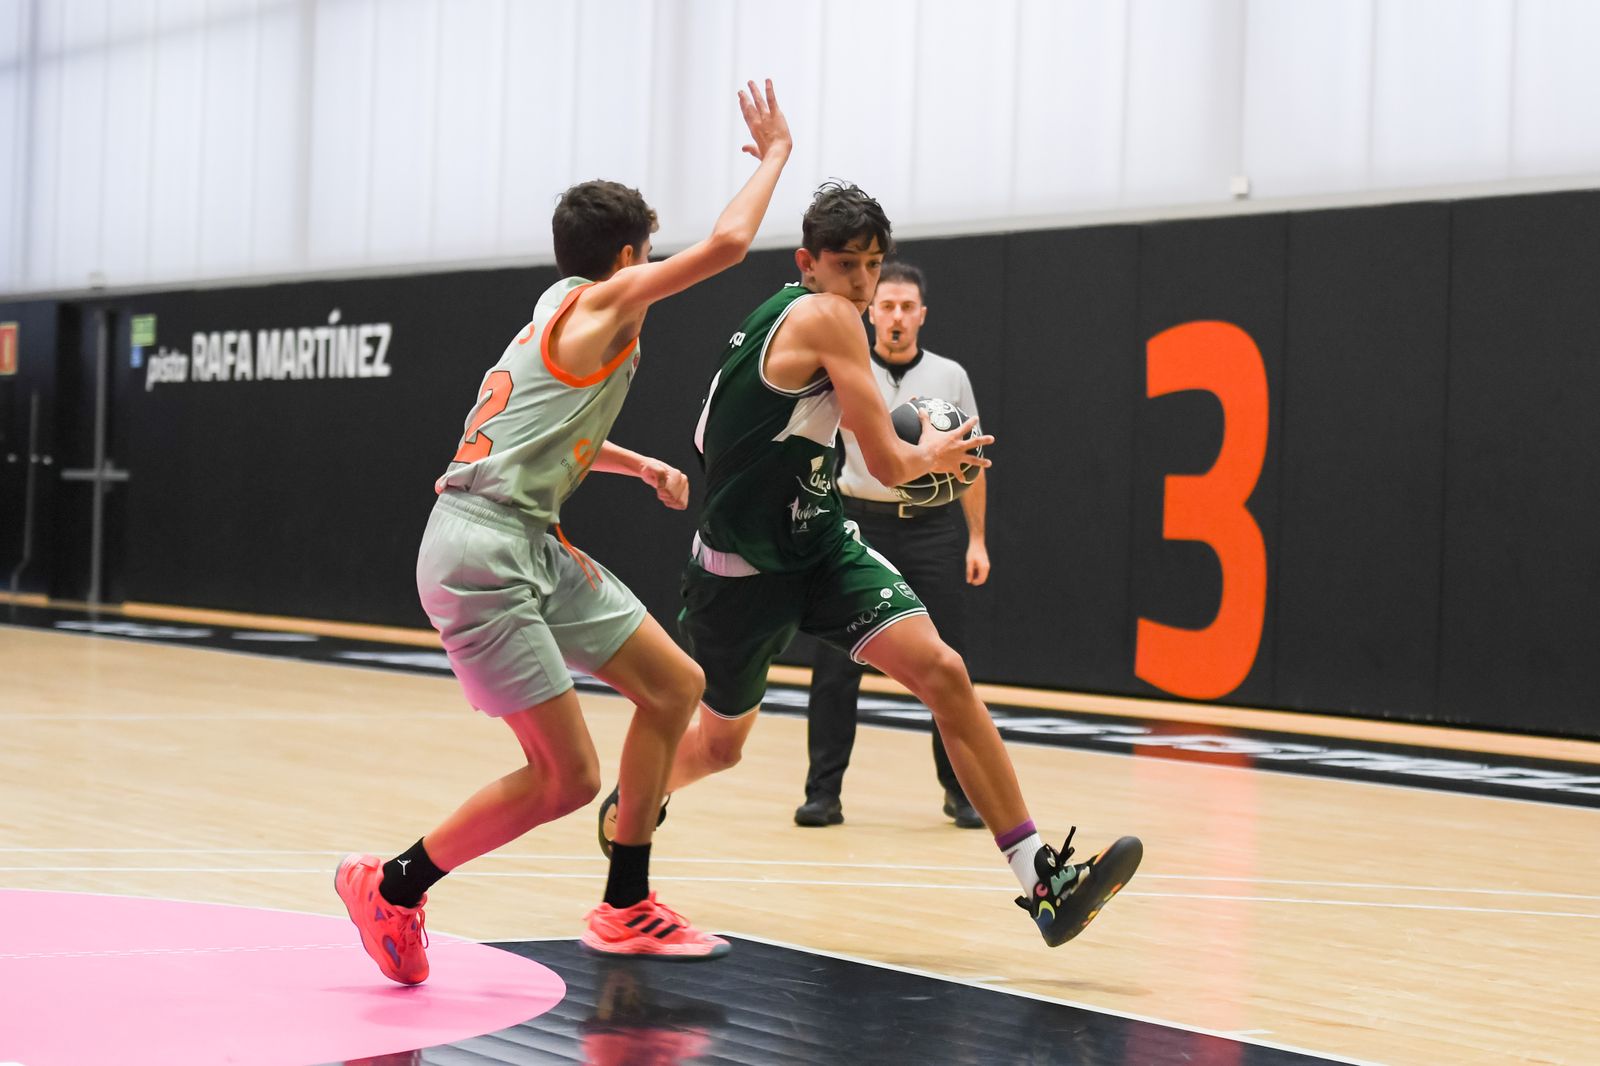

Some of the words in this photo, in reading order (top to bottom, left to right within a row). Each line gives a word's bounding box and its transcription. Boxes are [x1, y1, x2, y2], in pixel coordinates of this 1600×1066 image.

[191, 330, 253, 382] RAFA
[256, 308, 392, 380] MARTÍNEZ
[1134, 319, 1270, 700] 3
